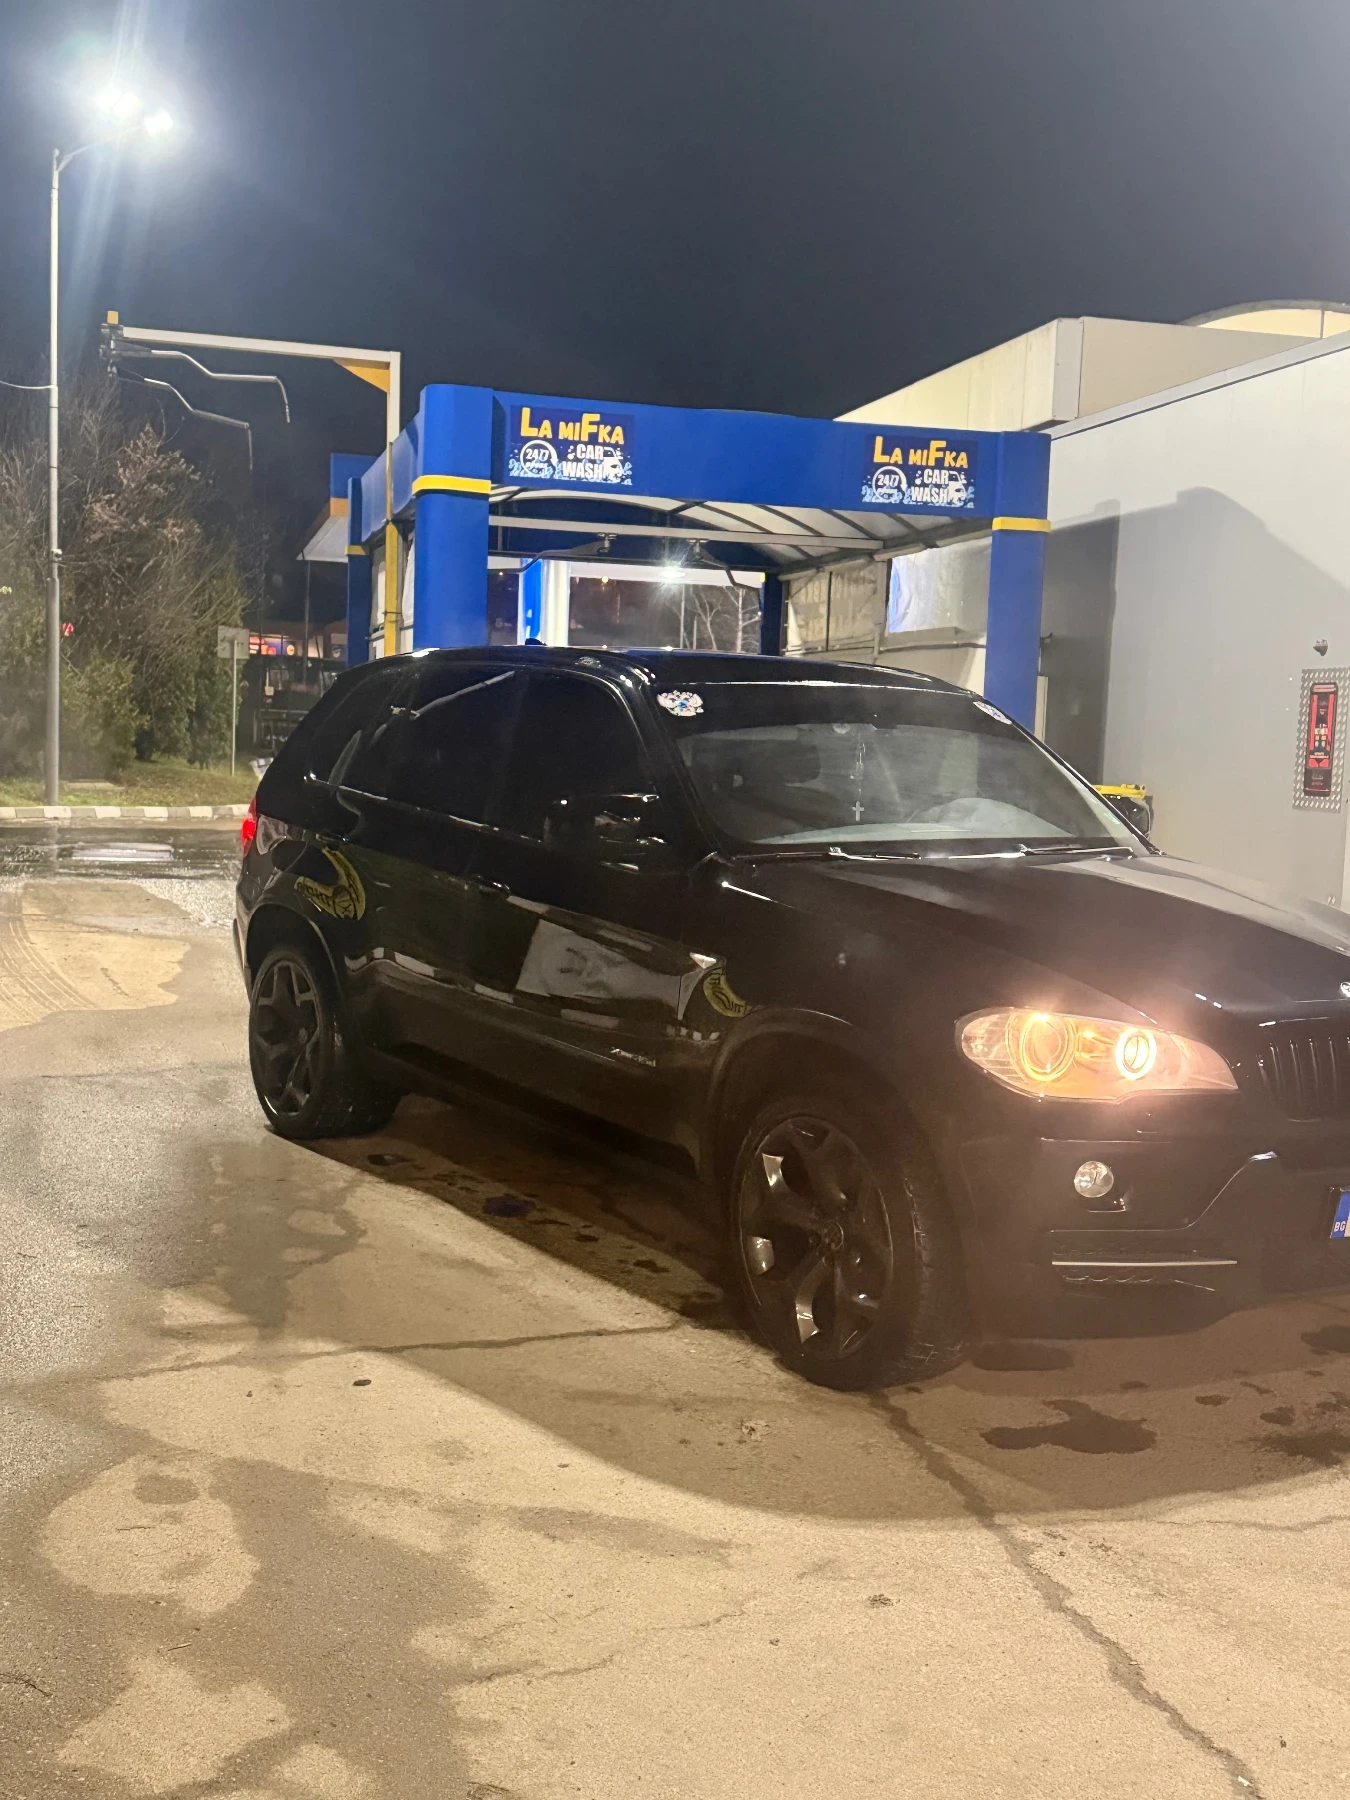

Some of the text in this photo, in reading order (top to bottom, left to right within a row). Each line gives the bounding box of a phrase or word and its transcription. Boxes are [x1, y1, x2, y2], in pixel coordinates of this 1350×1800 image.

[576, 444, 604, 460] CAR
[562, 461, 604, 479] WASH
[923, 468, 949, 485] CAR
[910, 486, 948, 504] WASH
[1334, 1221, 1346, 1232] BG
